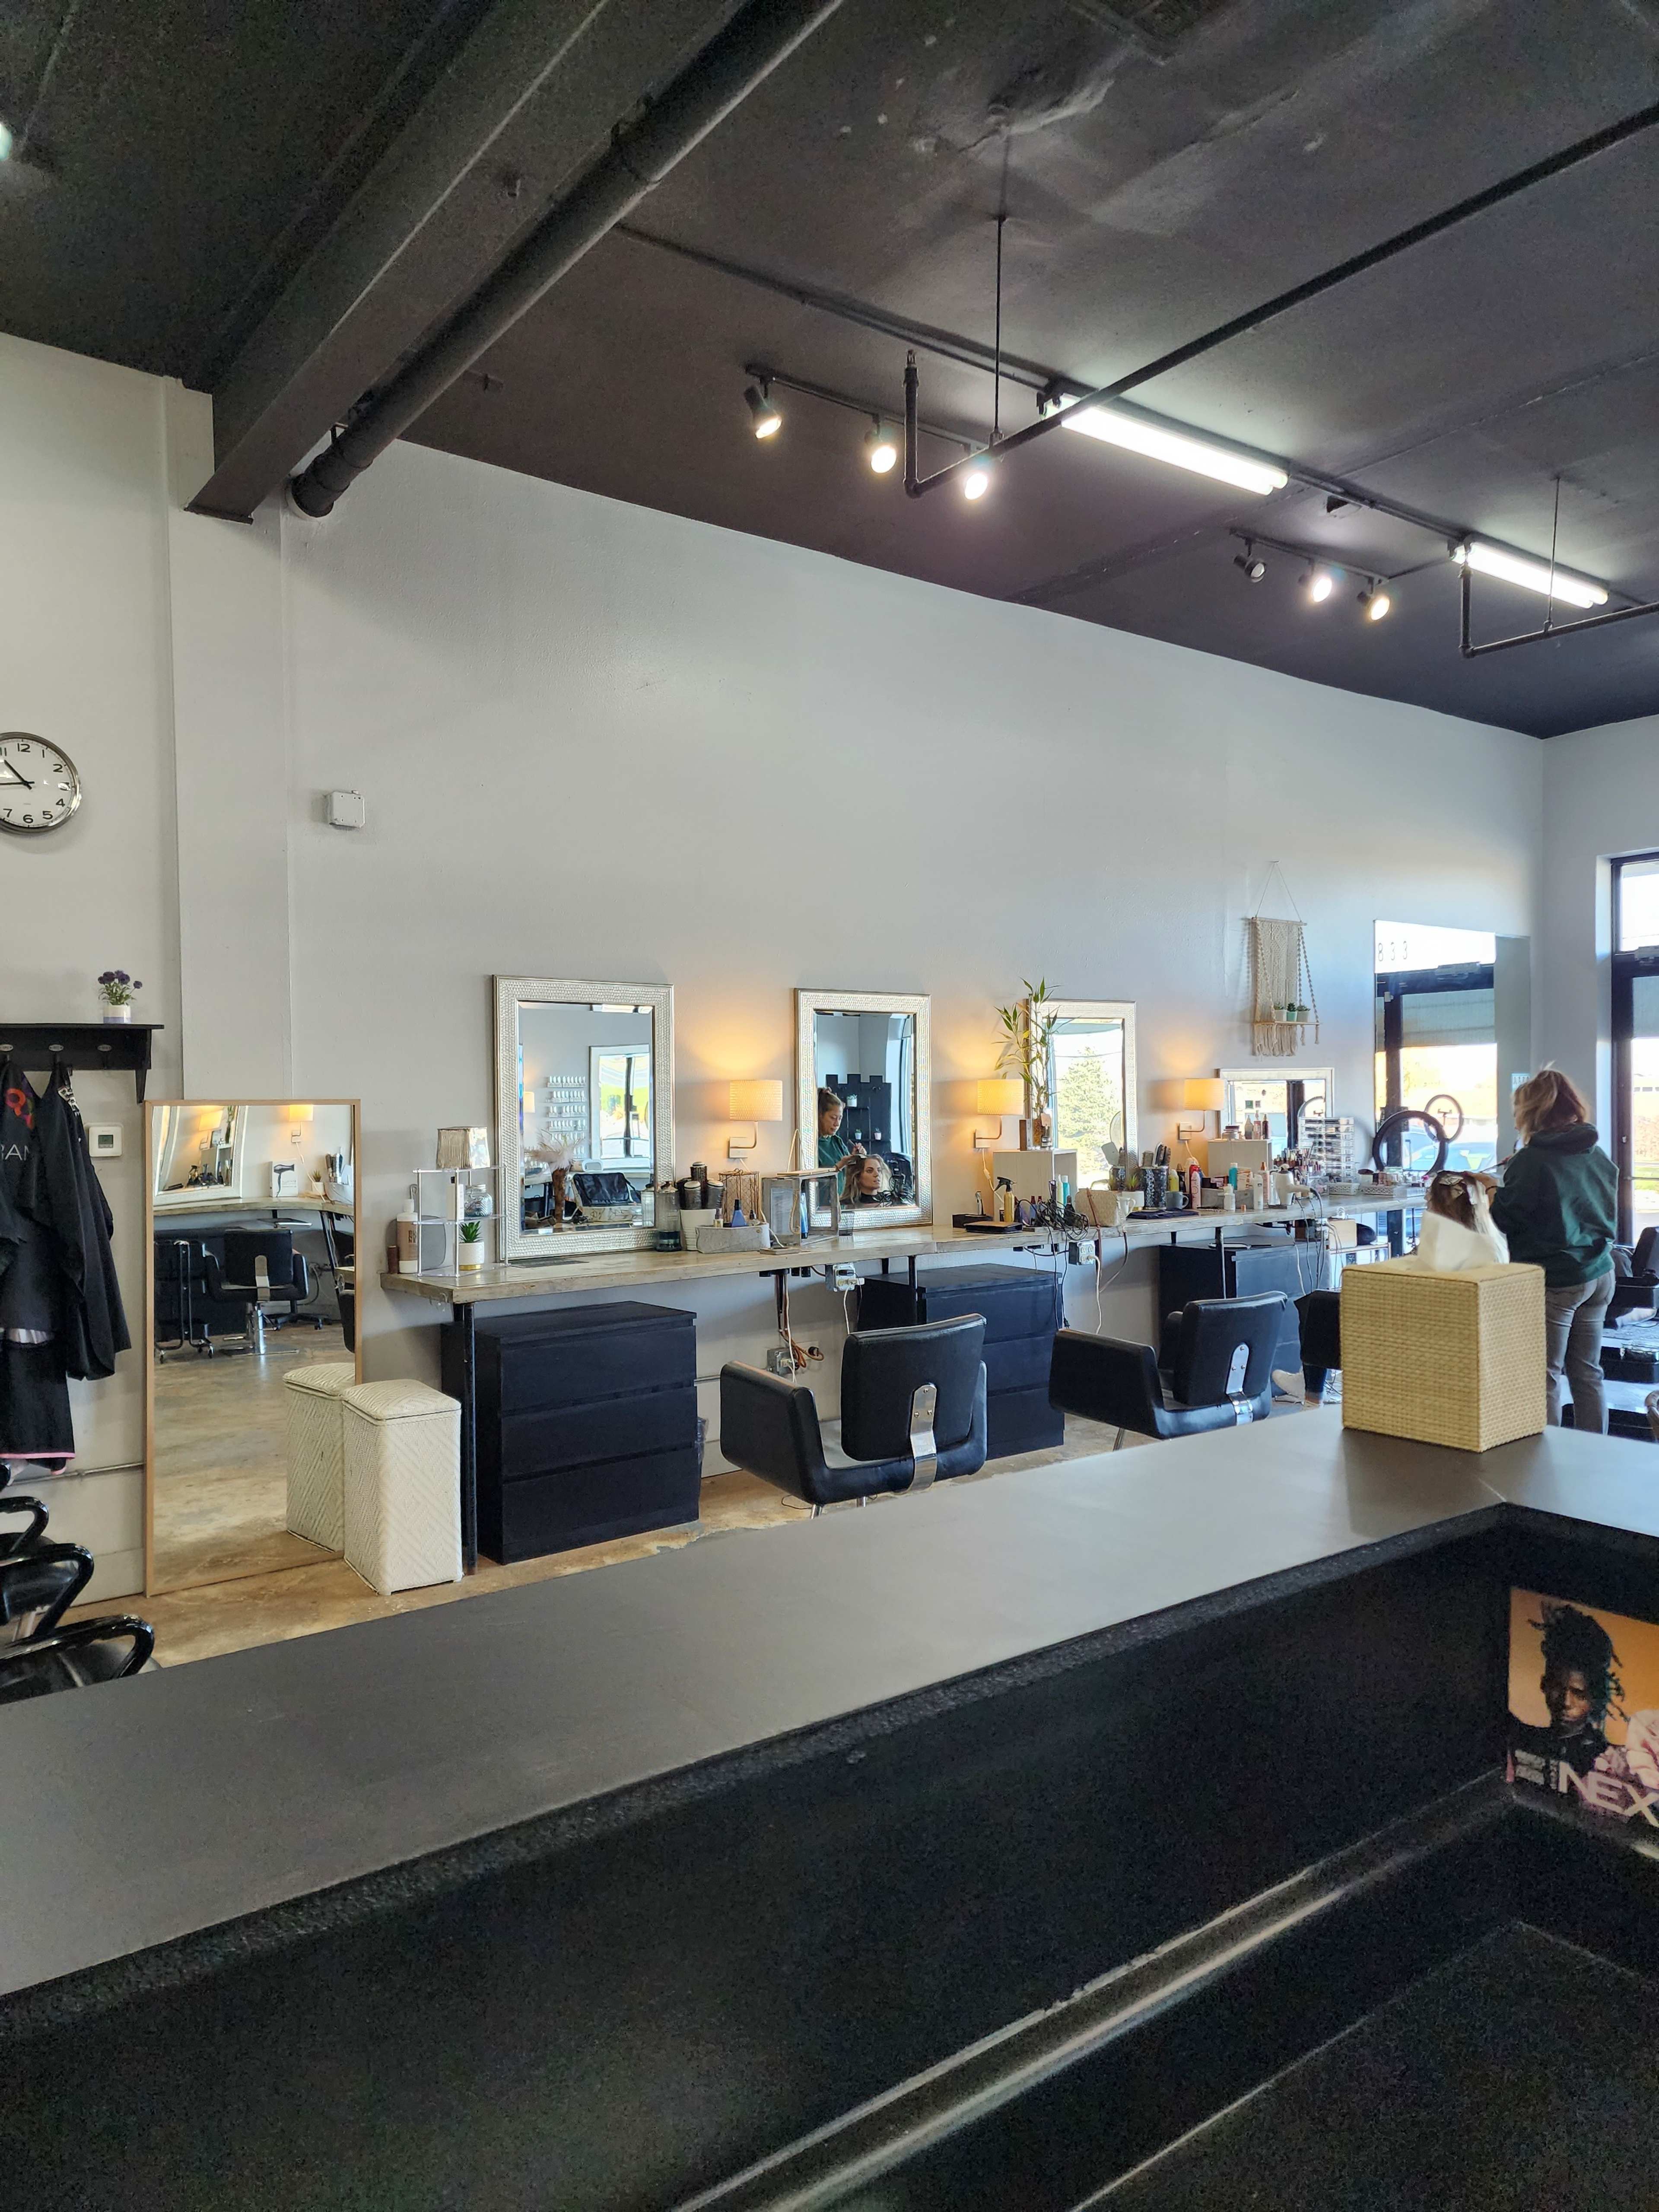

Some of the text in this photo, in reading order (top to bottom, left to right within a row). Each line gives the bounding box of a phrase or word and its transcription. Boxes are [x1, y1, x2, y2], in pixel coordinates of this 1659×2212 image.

[17, 743, 31, 753] 12
[42, 749, 45, 758] 1
[53, 763, 63, 772] 2
[56, 798, 65, 807] 4
[3, 808, 12, 817] 7
[42, 810, 53, 820] 5
[23, 814, 33, 823] 6
